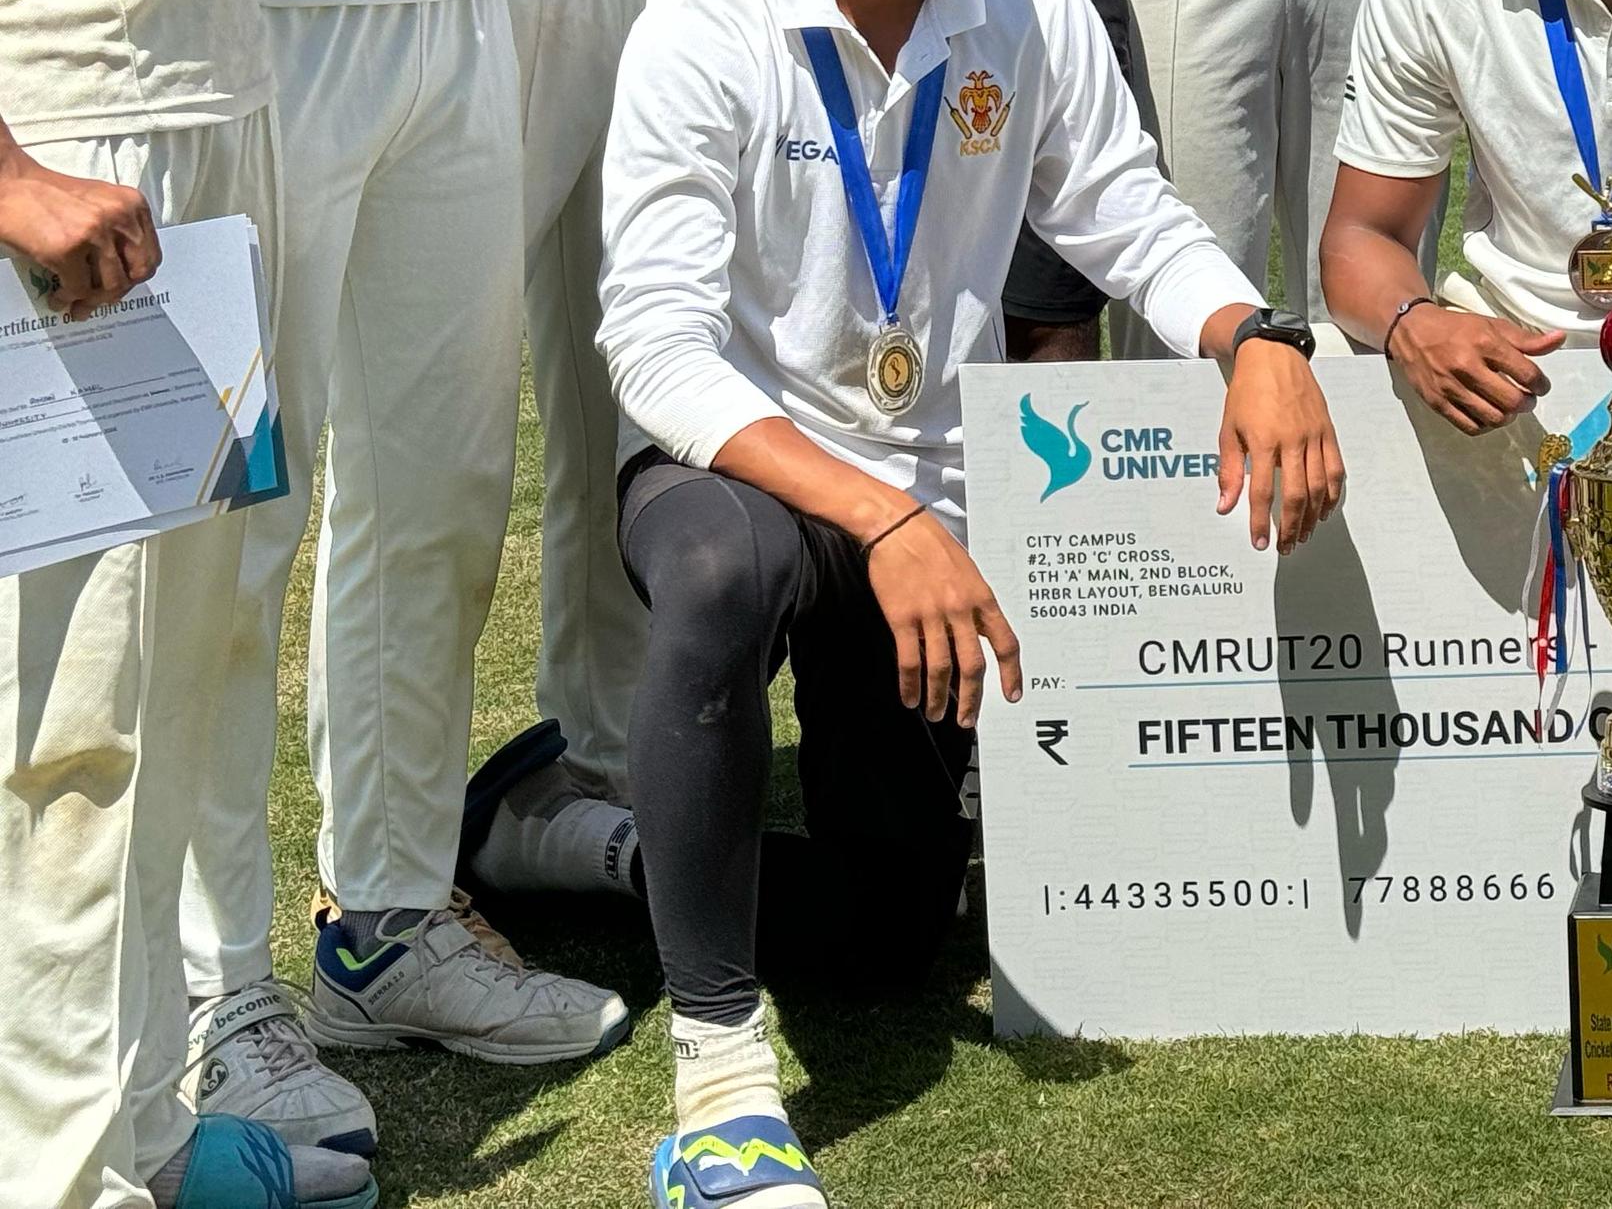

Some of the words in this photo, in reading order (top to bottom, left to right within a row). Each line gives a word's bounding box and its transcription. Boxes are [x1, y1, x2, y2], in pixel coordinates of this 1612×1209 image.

[959, 137, 1002, 157] KSCA
[0, 314, 58, 338] ertificate
[1101, 427, 1173, 453] CMR
[1102, 453, 1220, 481] UNIVER
[1026, 535, 1063, 548] CITY
[1068, 533, 1137, 547] CAMPUS
[1027, 553, 1052, 567] #2,
[1057, 552, 1087, 565] 3RD
[1117, 549, 1175, 563] CROSS,
[1028, 570, 1059, 583] 6TH
[1088, 568, 1134, 582] MAIN,
[1139, 567, 1171, 580] 2ND
[1177, 565, 1234, 579] BLOCK,
[1029, 587, 1072, 601] HRBR
[1077, 585, 1143, 599] LAYOUT,
[1148, 582, 1244, 597] BENGALURU
[1030, 604, 1087, 618] 560043
[1093, 603, 1138, 616] INDIA
[1138, 634, 1362, 676] CMRUT20
[1383, 632, 1559, 668] Runners
[1031, 676, 1066, 690] PAY:
[1138, 715, 1315, 755] FIFTEEN
[1326, 708, 1574, 750] THOUSAND
[1348, 873, 1555, 904] 77888666
[367, 980, 393, 1006] SIERRA
[393, 971, 405, 985] 2.0
[214, 993, 281, 1030] become
[1590, 1013, 1612, 1032] State
[1585, 1041, 1612, 1059] Cricket
